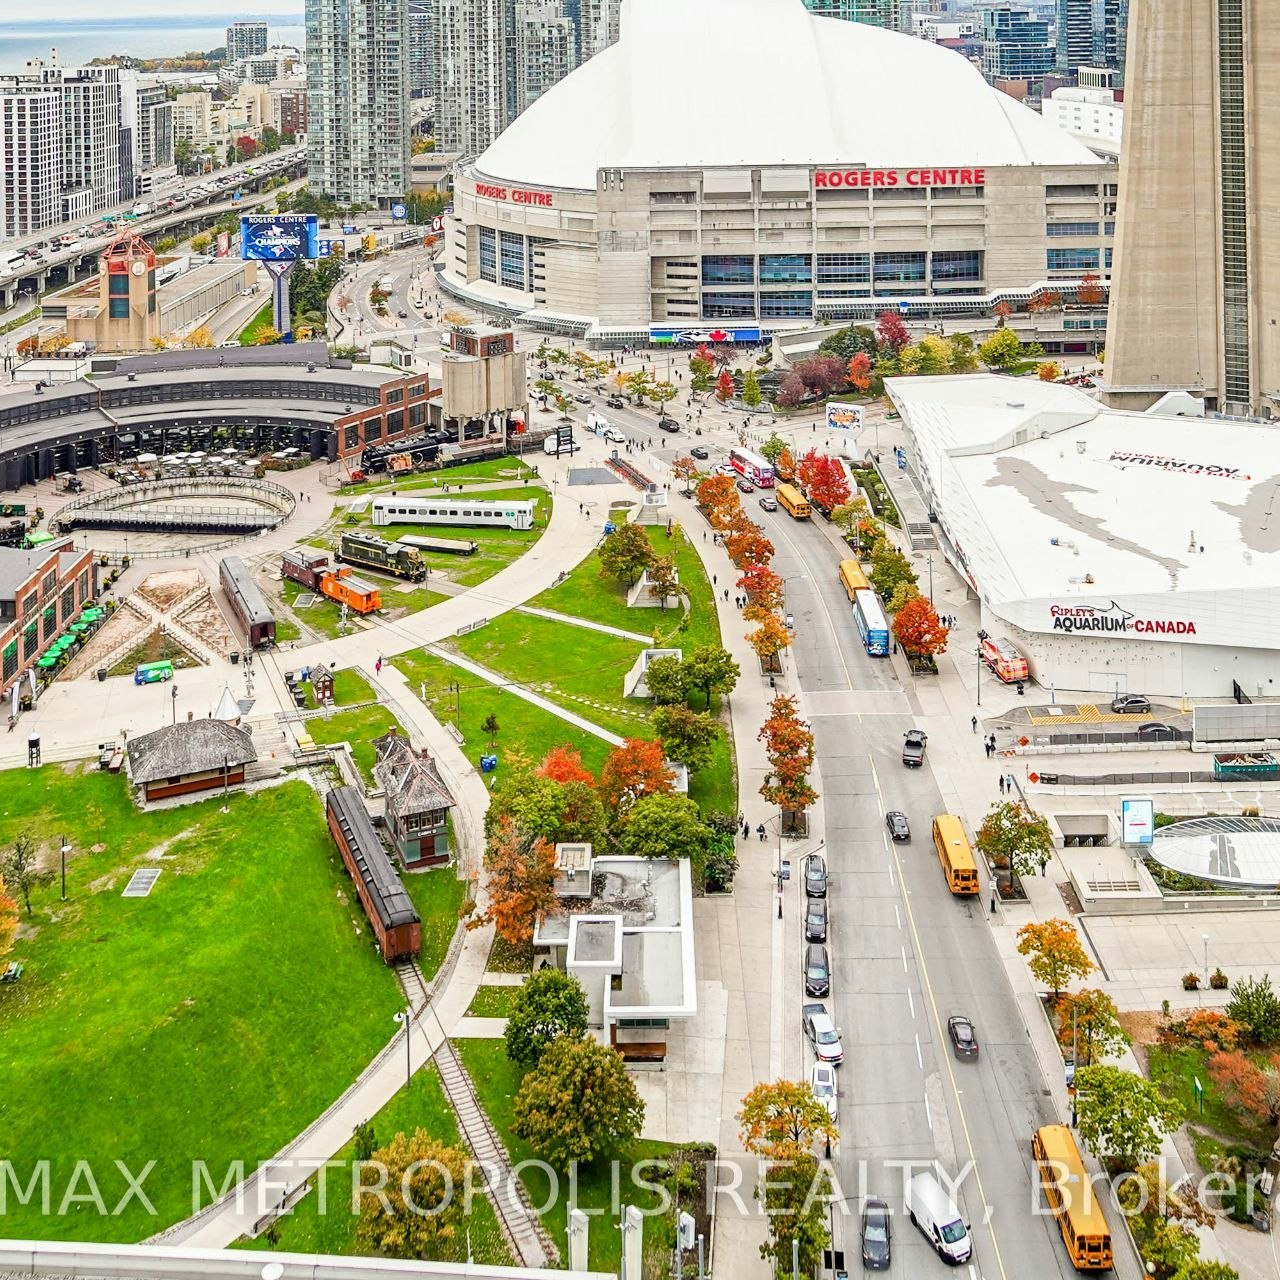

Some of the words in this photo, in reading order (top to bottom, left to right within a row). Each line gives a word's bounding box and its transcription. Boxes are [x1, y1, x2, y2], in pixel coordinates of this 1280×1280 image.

[815, 170, 897, 187] ROGERS
[906, 169, 985, 185] CENTRE
[476, 183, 506, 200] ROGERS
[512, 189, 552, 206] CENTRE
[1110, 454, 1239, 474] AQUARIUM
[1050, 605, 1095, 617] RIPLEY'S
[1054, 616, 1126, 632] AQUARIUM
[1135, 620, 1196, 634] CANADA
